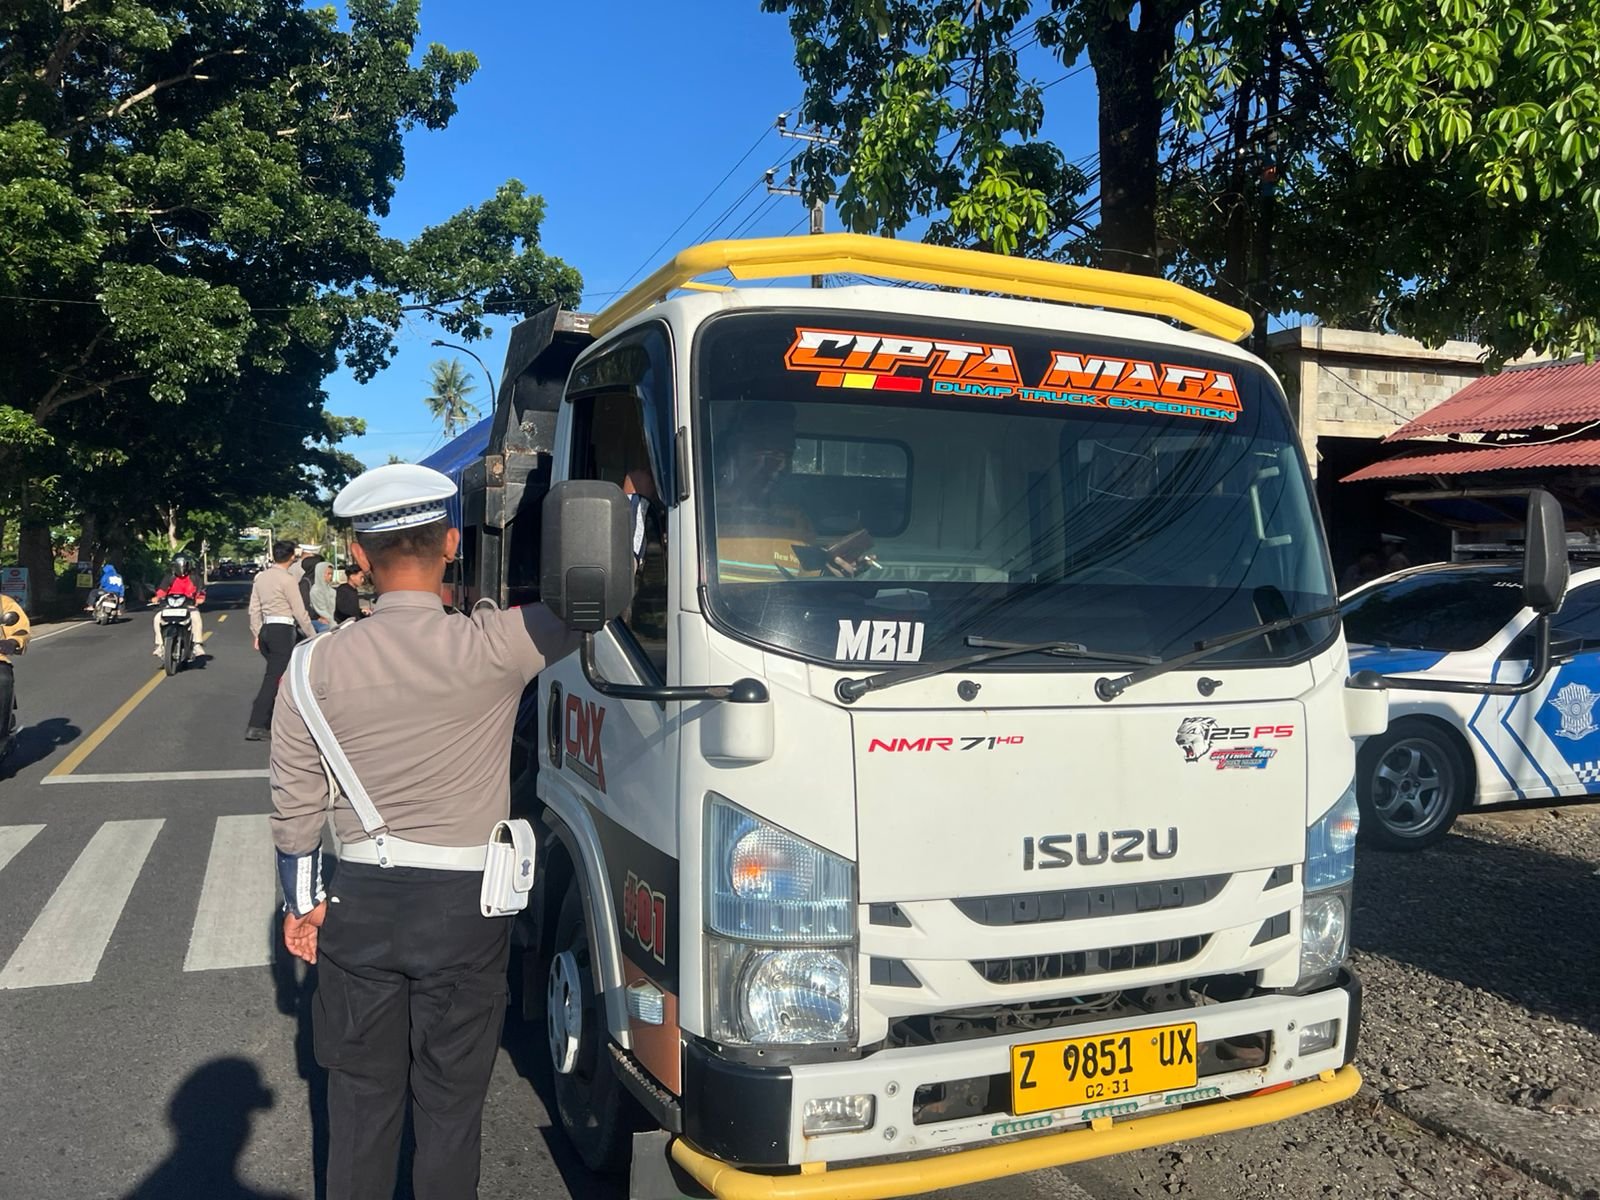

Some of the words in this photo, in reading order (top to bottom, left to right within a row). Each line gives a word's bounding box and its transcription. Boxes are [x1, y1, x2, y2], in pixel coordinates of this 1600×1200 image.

[786, 330, 1017, 380] CIPTA
[1041, 353, 1238, 403] NIAGA
[934, 380, 1012, 397] DUMP
[1019, 388, 1098, 406] TRUCK
[1107, 396, 1236, 421] EXPEDITION
[835, 619, 925, 662] MBU
[868, 737, 953, 752] NMR
[1203, 727, 1251, 741] 125
[1253, 725, 1294, 739] PS
[1023, 826, 1179, 871] ISUZU
[1019, 1050, 1037, 1089] Z
[1063, 1036, 1133, 1082] 9851
[1159, 1028, 1193, 1067] UX
